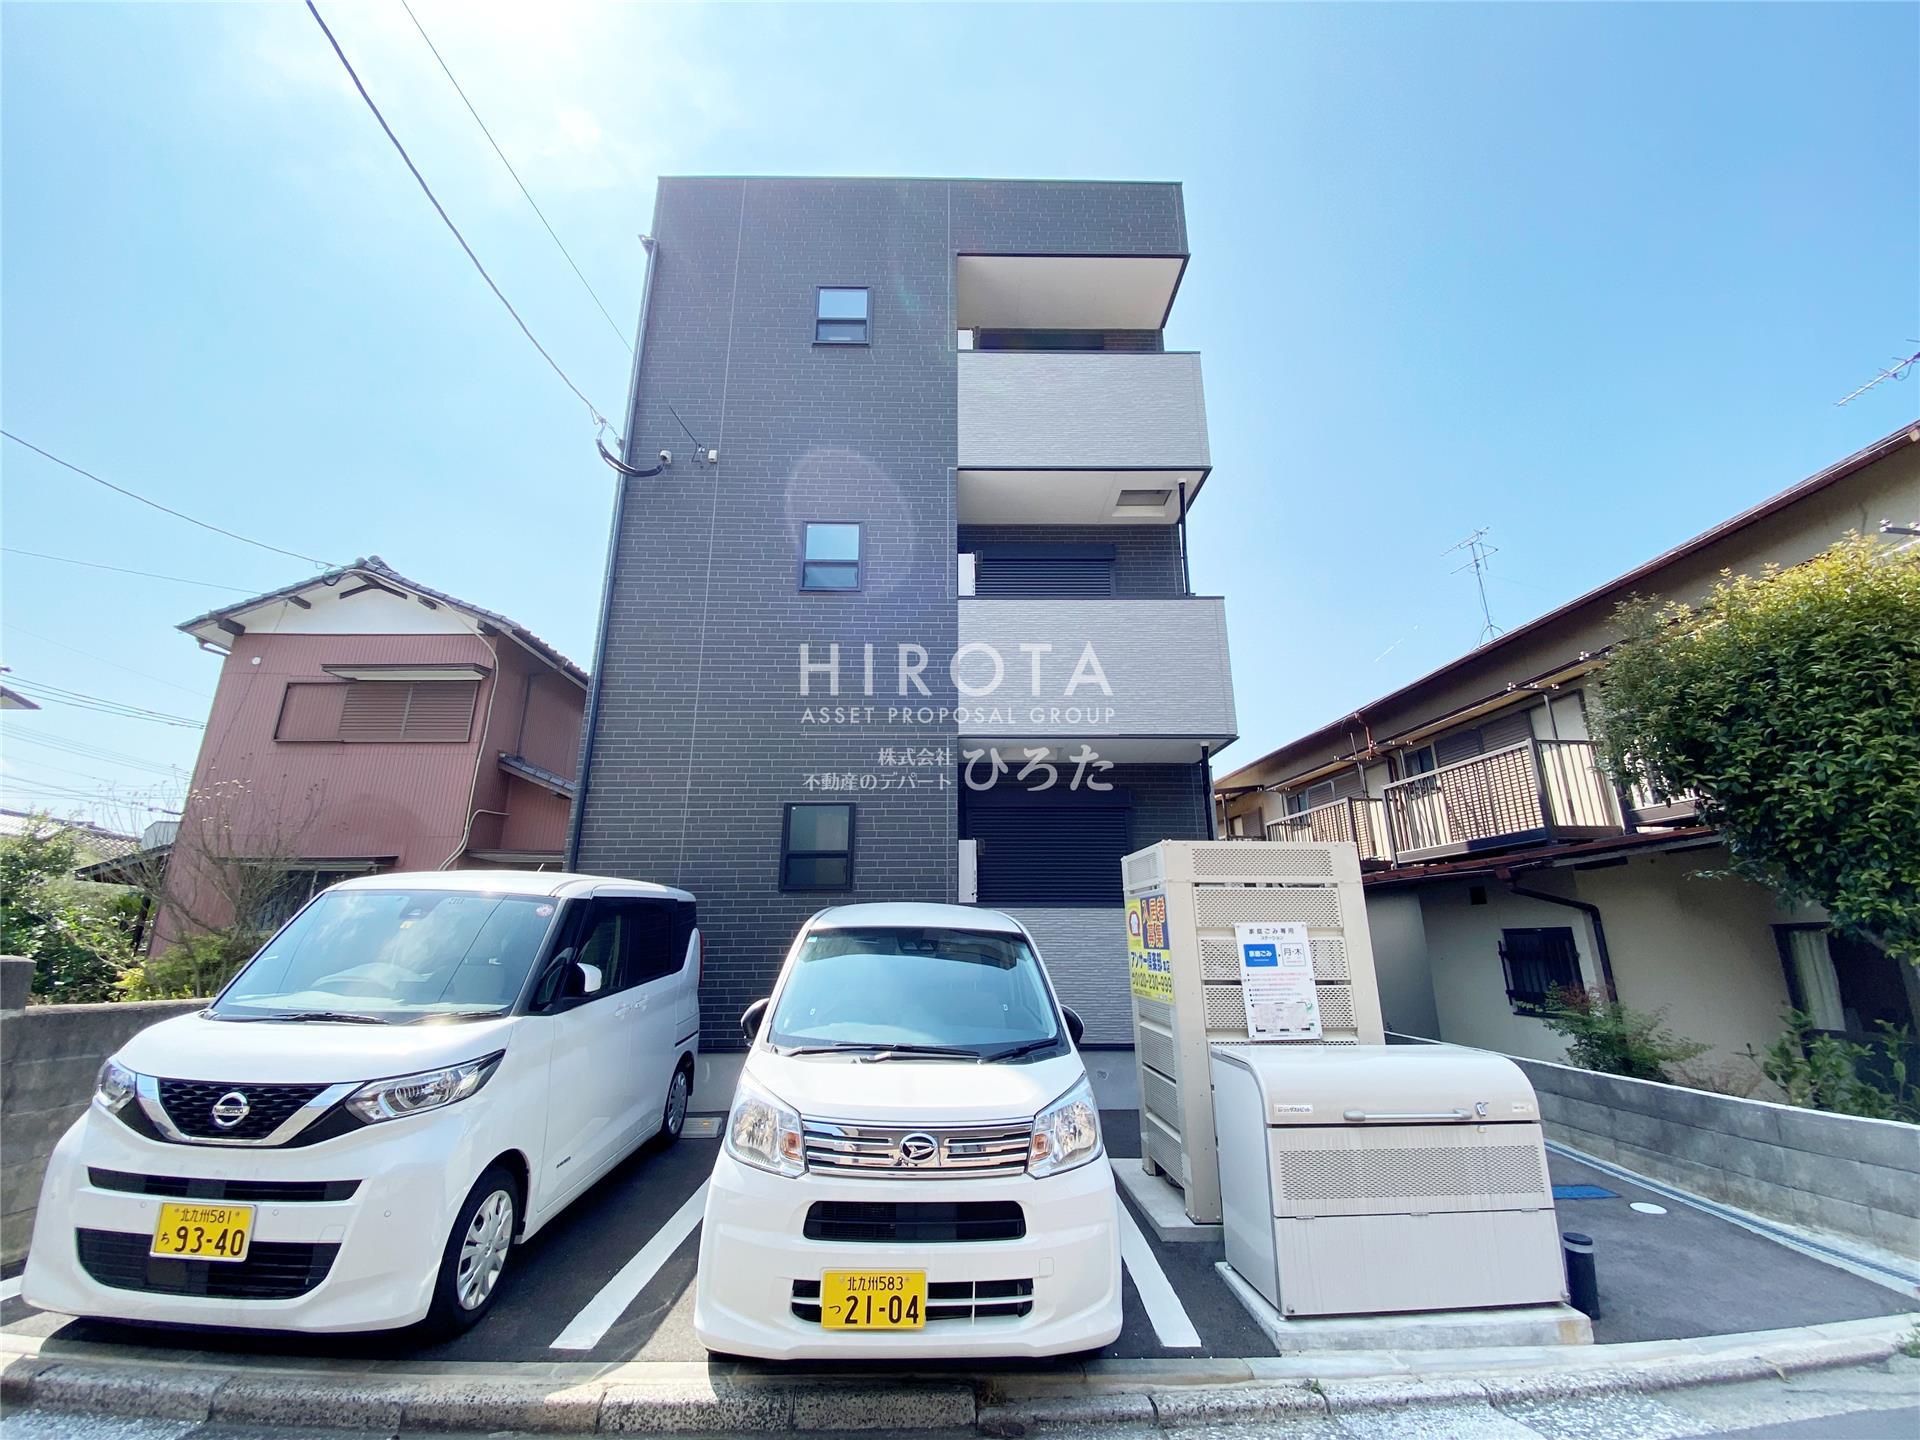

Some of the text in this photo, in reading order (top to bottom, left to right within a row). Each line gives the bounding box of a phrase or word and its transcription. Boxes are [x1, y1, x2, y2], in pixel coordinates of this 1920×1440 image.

[180, 1208, 232, 1224] 北九州581
[174, 1226, 245, 1256] 93-40
[847, 1276, 904, 1291] 北九州583
[844, 1295, 919, 1324] 21-04
